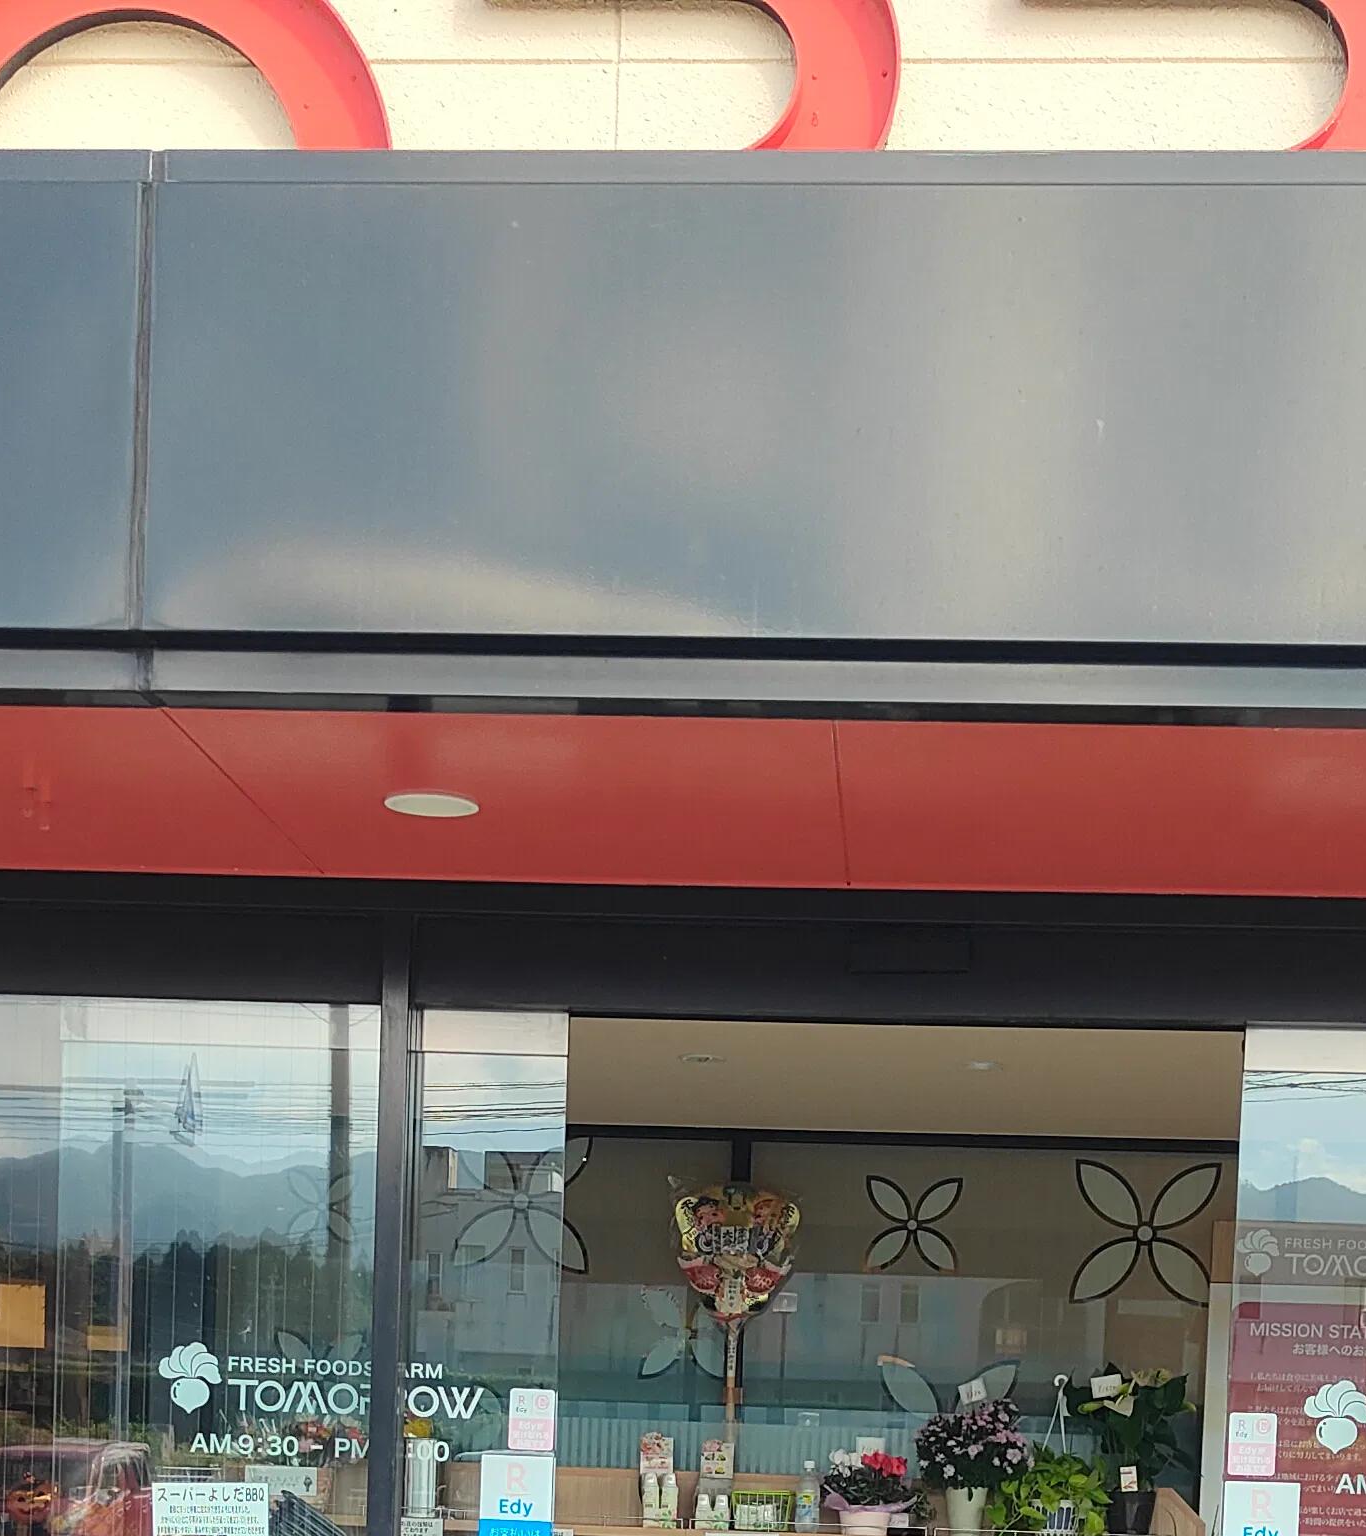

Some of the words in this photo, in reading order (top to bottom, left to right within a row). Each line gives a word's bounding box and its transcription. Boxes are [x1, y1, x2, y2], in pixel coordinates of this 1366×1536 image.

[1285, 1238, 1332, 1249] FRESH
[1250, 1322, 1323, 1338] MISSION
[227, 1355, 296, 1375] FRESH
[303, 1358, 372, 1377] FOODS
[227, 1378, 485, 1420] TOMOOW
[189, 1432, 232, 1454] AM
[238, 1433, 299, 1457] 9:30
[157, 1486, 265, 1503] スーパーよしだBBQ
[499, 1498, 533, 1517] Edy
